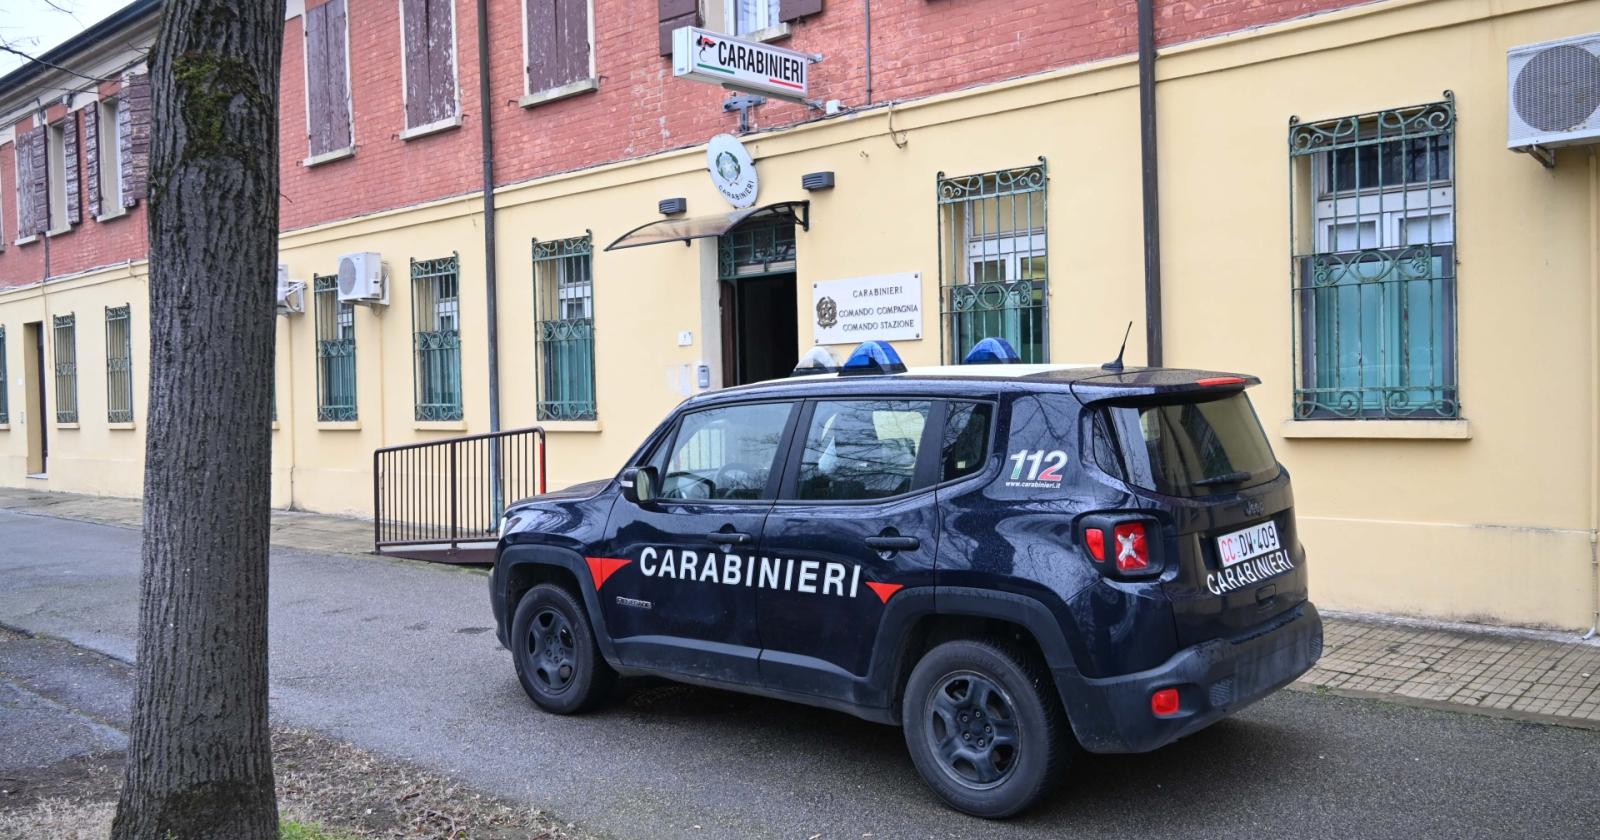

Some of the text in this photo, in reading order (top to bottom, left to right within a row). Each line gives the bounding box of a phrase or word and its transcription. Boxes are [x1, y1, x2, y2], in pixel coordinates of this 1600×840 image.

[718, 41, 803, 84] CARABINIERI
[718, 180, 754, 201] CARABINIERI
[852, 286, 903, 298] CARABINIERI
[838, 304, 919, 318] COMANDO COMPAGNIA
[842, 319, 915, 332] COMANDO STAZIONE
[1010, 449, 1068, 481] 112
[1005, 481, 1061, 489] www.carabinieri.it
[1221, 525, 1276, 562] CC DW 409
[639, 546, 862, 598] CARABINIERI
[1206, 549, 1295, 595] CARABINIERI
